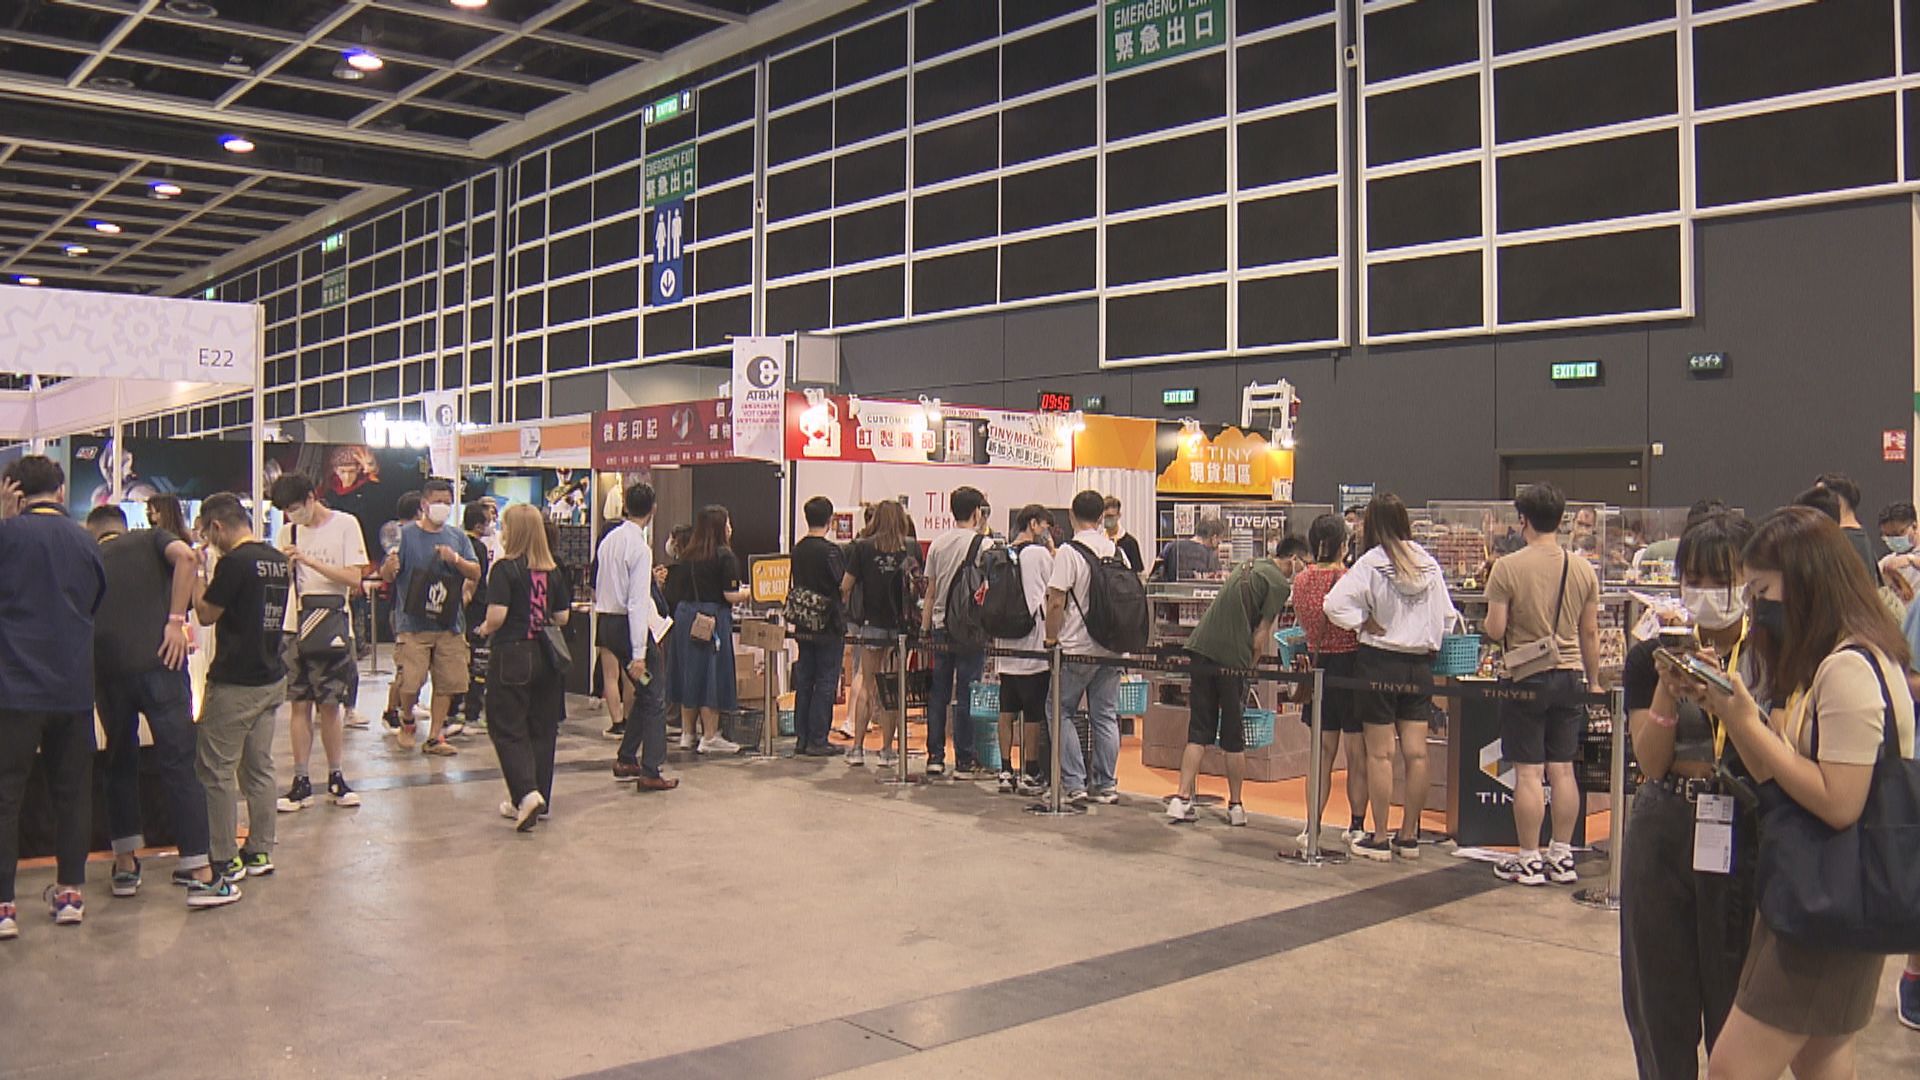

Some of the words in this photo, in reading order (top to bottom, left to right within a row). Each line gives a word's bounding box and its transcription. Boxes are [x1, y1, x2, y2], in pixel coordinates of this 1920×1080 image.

[1115, 10, 1213, 62] 緊急出口
[199, 348, 233, 367] E22
[1553, 364, 1575, 378] EXIT
[1042, 394, 1070, 410] 09:56
[1207, 446, 1253, 461] TINY
[1226, 515, 1287, 529] TOYEAST
[256, 560, 288, 577] STAF
[1476, 791, 1515, 805] TIN
